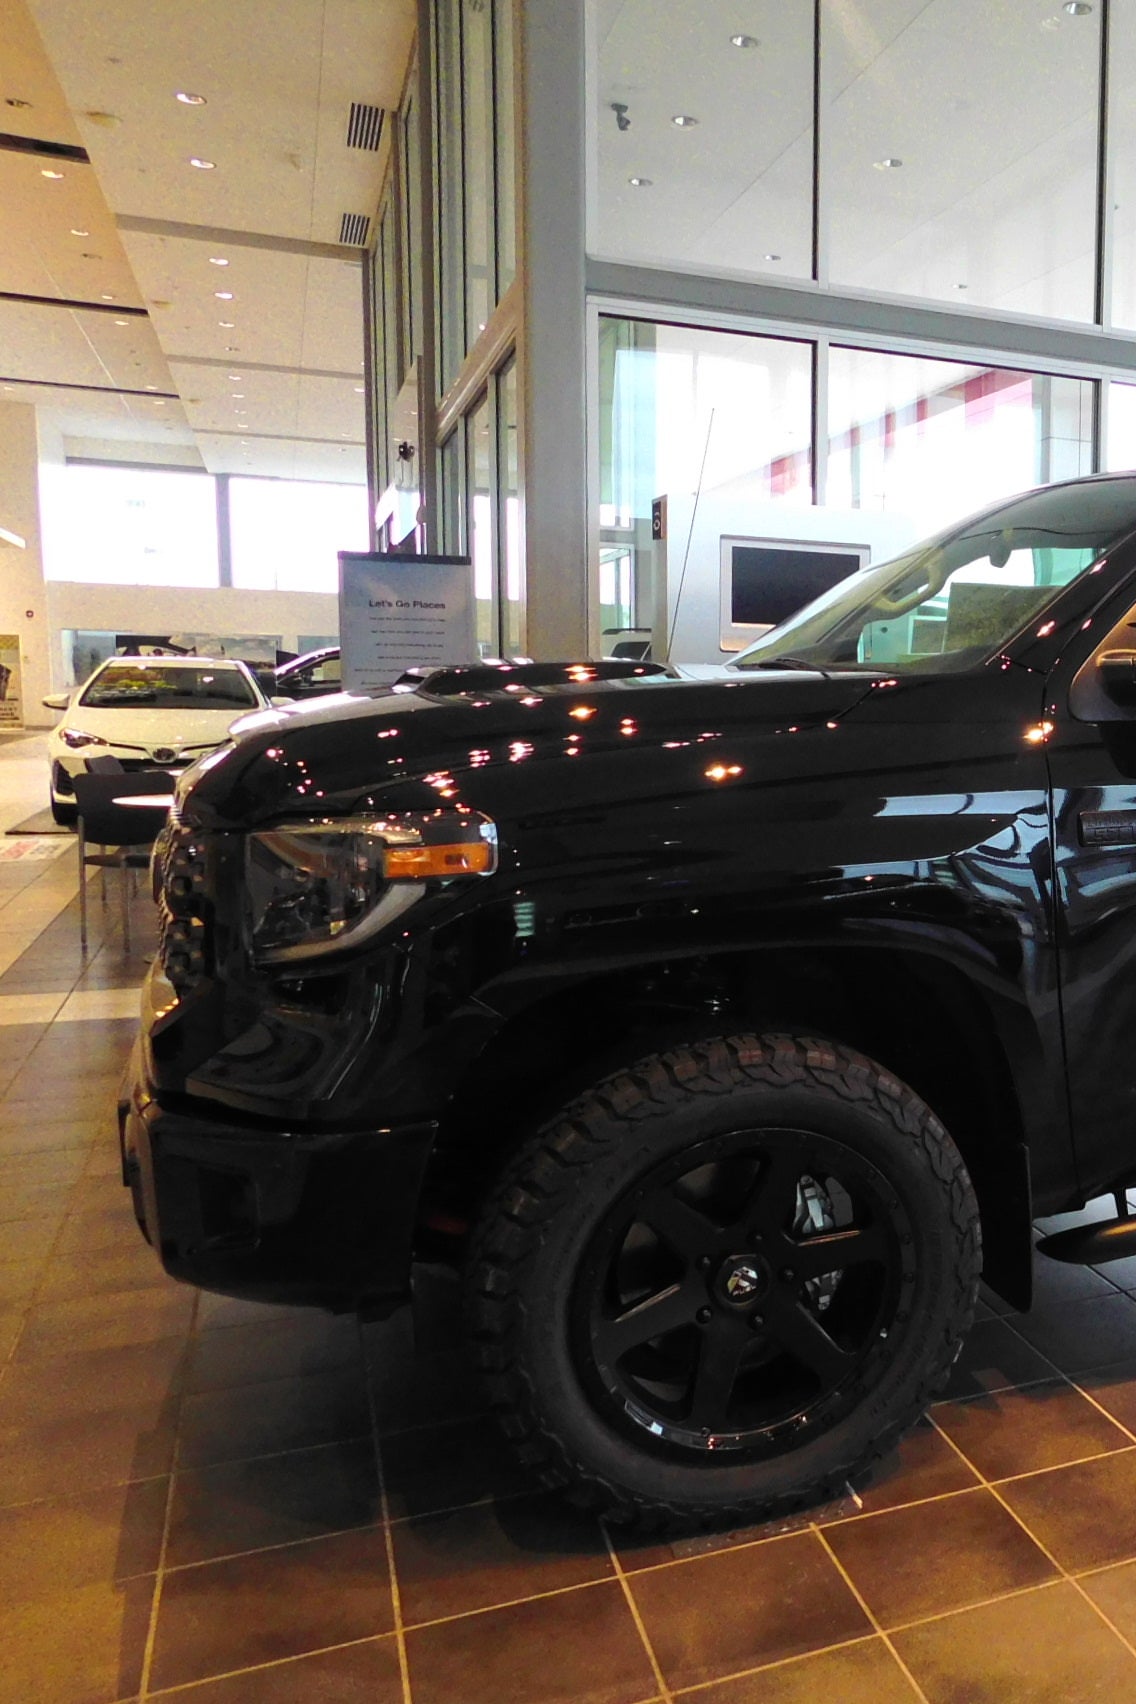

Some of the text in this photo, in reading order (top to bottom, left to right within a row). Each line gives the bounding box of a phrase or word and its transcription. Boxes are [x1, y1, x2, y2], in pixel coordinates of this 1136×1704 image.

[369, 599, 446, 609] Let's Go Places
